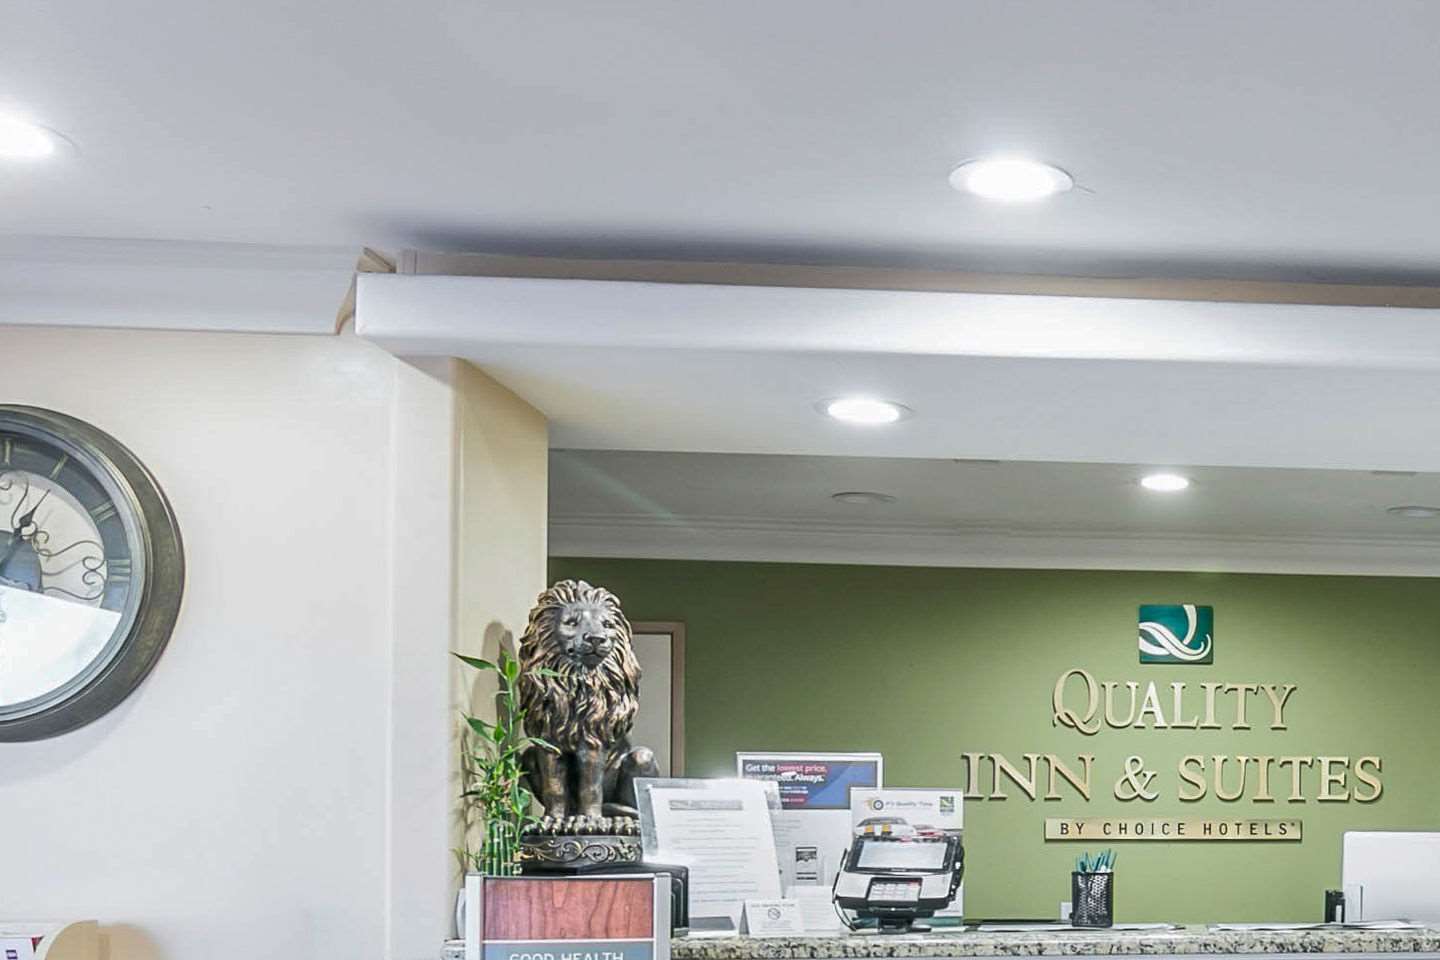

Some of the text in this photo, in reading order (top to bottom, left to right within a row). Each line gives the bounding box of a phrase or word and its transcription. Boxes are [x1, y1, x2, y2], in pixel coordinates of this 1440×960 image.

[1052, 669, 1297, 735] QUALITY
[963, 752, 1384, 802] INN & SUITES
[1060, 823, 1085, 835] BY
[1103, 823, 1185, 835] CHOICE
